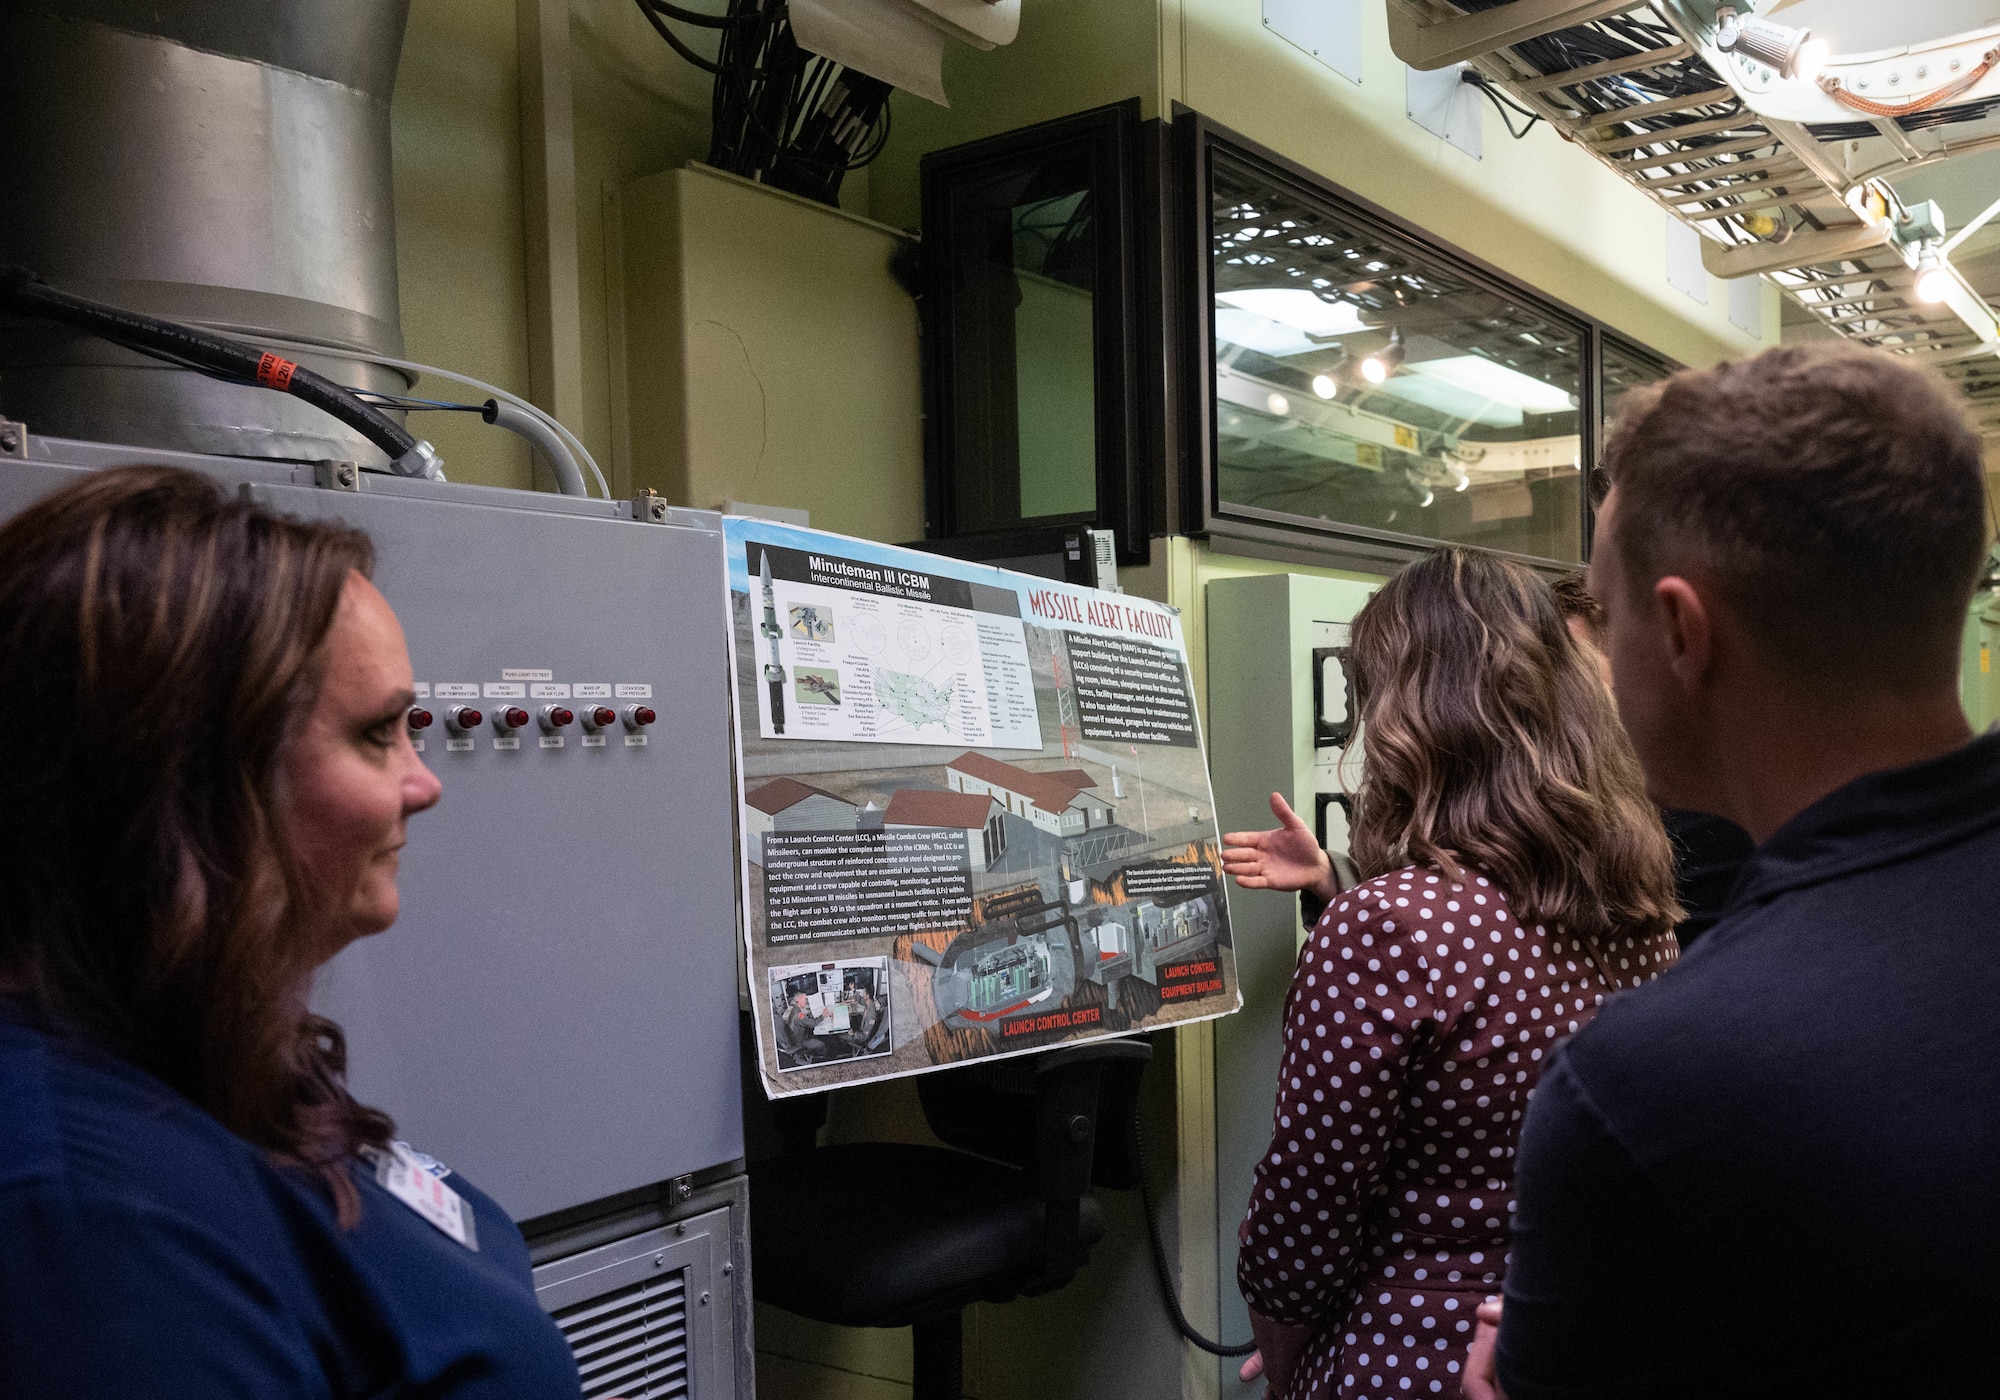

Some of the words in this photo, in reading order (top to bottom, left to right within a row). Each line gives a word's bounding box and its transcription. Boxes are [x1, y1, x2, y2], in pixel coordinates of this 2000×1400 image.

[809, 556, 881, 581] Minuteman
[884, 569, 896, 584] III
[898, 572, 930, 590] ICBM
[811, 572, 874, 591] Intercontinental
[876, 582, 905, 596] Ballistic
[906, 588, 931, 601] Missile
[1028, 587, 1083, 624] MISSILE
[1087, 600, 1123, 631] ALERT
[1125, 606, 1173, 640] FACILITY
[1074, 635, 1091, 645] Missile
[1092, 639, 1104, 647] Alert
[1105, 641, 1122, 652] Facility
[1122, 644, 1137, 654] (MAF)
[1148, 649, 1177, 661] above-ground
[1071, 647, 1091, 659] support
[1092, 651, 1112, 662] building
[1120, 655, 1128, 663] the
[1129, 657, 1145, 666] Launch
[1145, 660, 1161, 669] Control
[1162, 663, 1177, 671] Centers
[1073, 660, 1089, 671] (LCCs)
[1090, 663, 1114, 675] consisting
[1124, 668, 1143, 679] security
[1143, 671, 1159, 680] control
[1075, 673, 1084, 683] ing
[1120, 680, 1140, 691] sleeping
[1168, 687, 1184, 697] security
[1096, 689, 1113, 700] facility
[1145, 696, 1155, 704] chef
[1155, 697, 1175, 706] stationed
[849, 846, 873, 855] complex
[768, 860, 808, 870] underground
[845, 857, 873, 865] reinforced
[923, 854, 945, 863] designed
[769, 873, 781, 881] tect
[823, 870, 855, 879] equipment
[879, 867, 902, 875] essential
[769, 884, 803, 895] equipment
[838, 881, 860, 890] capable
[942, 875, 965, 884] launching
[1164, 965, 1189, 979] LAUNCH
[1190, 961, 1216, 975] CONTROL
[1162, 983, 1195, 999] EQUIPMENT
[1196, 979, 1223, 993] BUILDING
[1004, 1018, 1035, 1037] LAUNCH
[1037, 1013, 1071, 1030] CONTROL
[1072, 1008, 1100, 1024] CENTER
